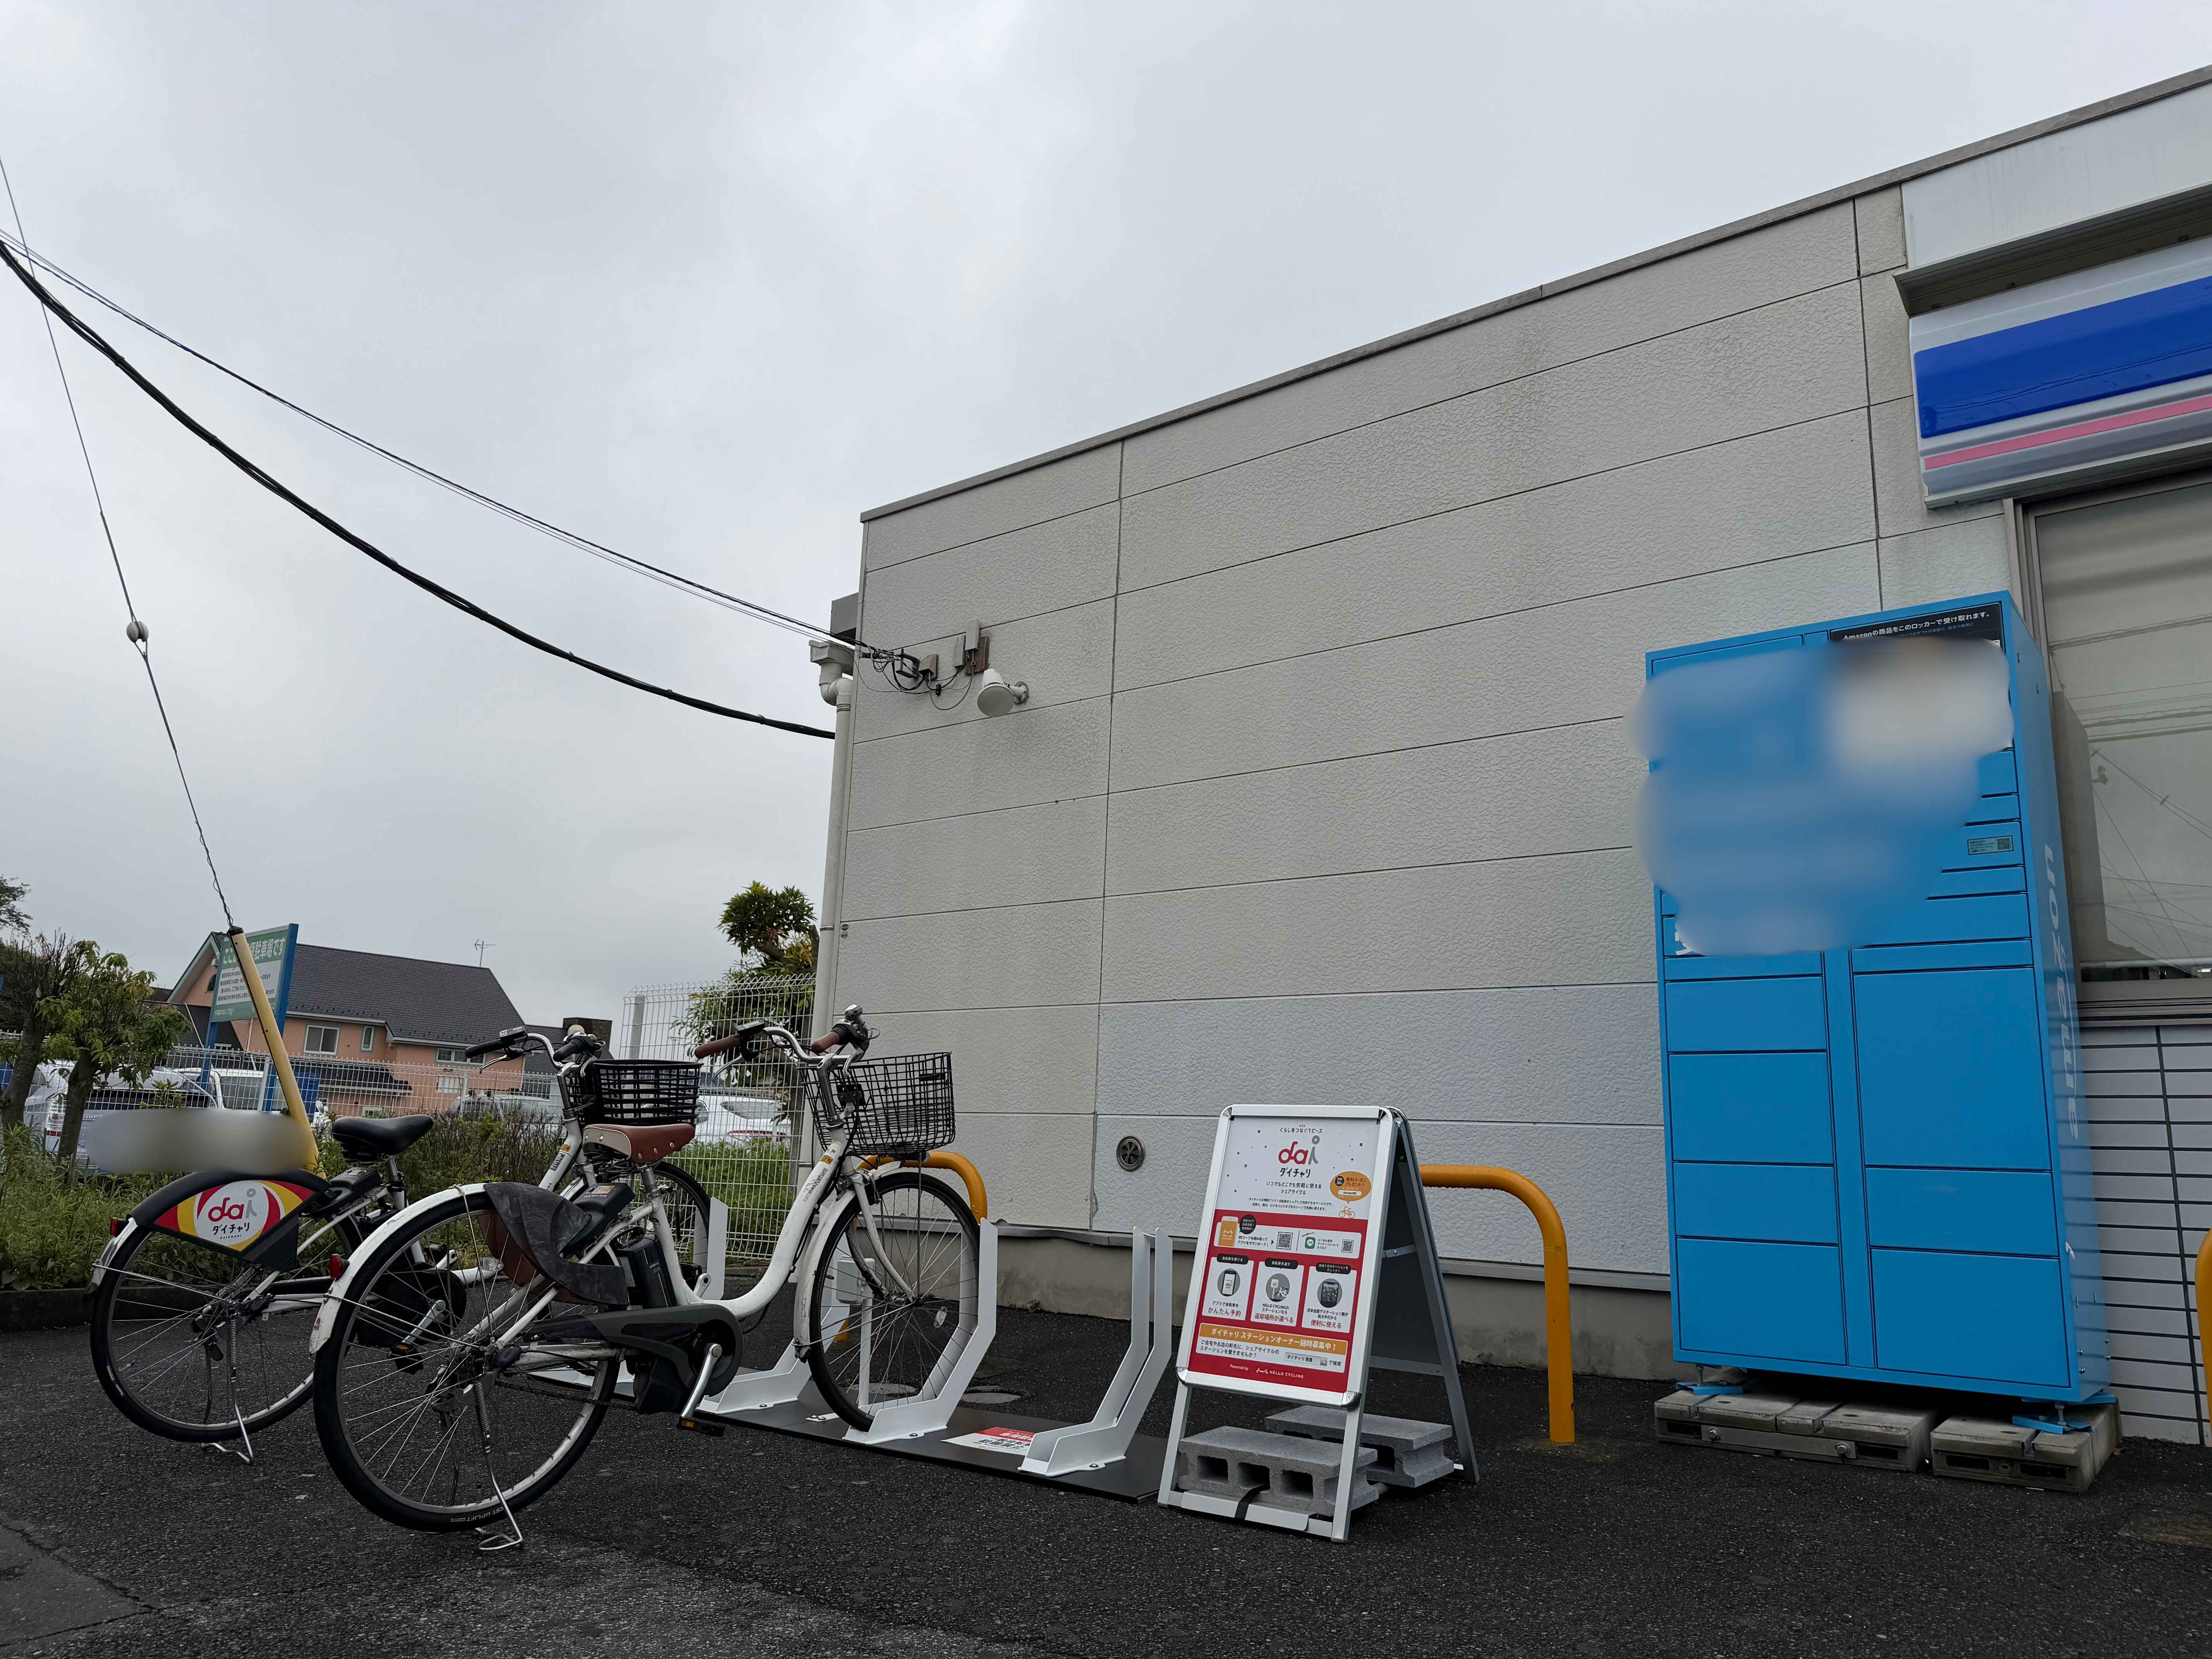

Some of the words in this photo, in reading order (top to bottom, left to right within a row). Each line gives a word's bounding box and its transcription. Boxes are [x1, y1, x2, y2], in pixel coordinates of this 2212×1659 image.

[1278, 1135, 1320, 1165] dai
[1280, 1167, 1311, 1178] ダイチャリ
[208, 1188, 257, 1222] dai
[213, 1222, 250, 1235] ダイチャリ
[1208, 1307, 1242, 1317] かんたん予約
[1255, 1313, 1294, 1323] 返却場所が選べる
[1311, 1319, 1342, 1329] 便利に使える
